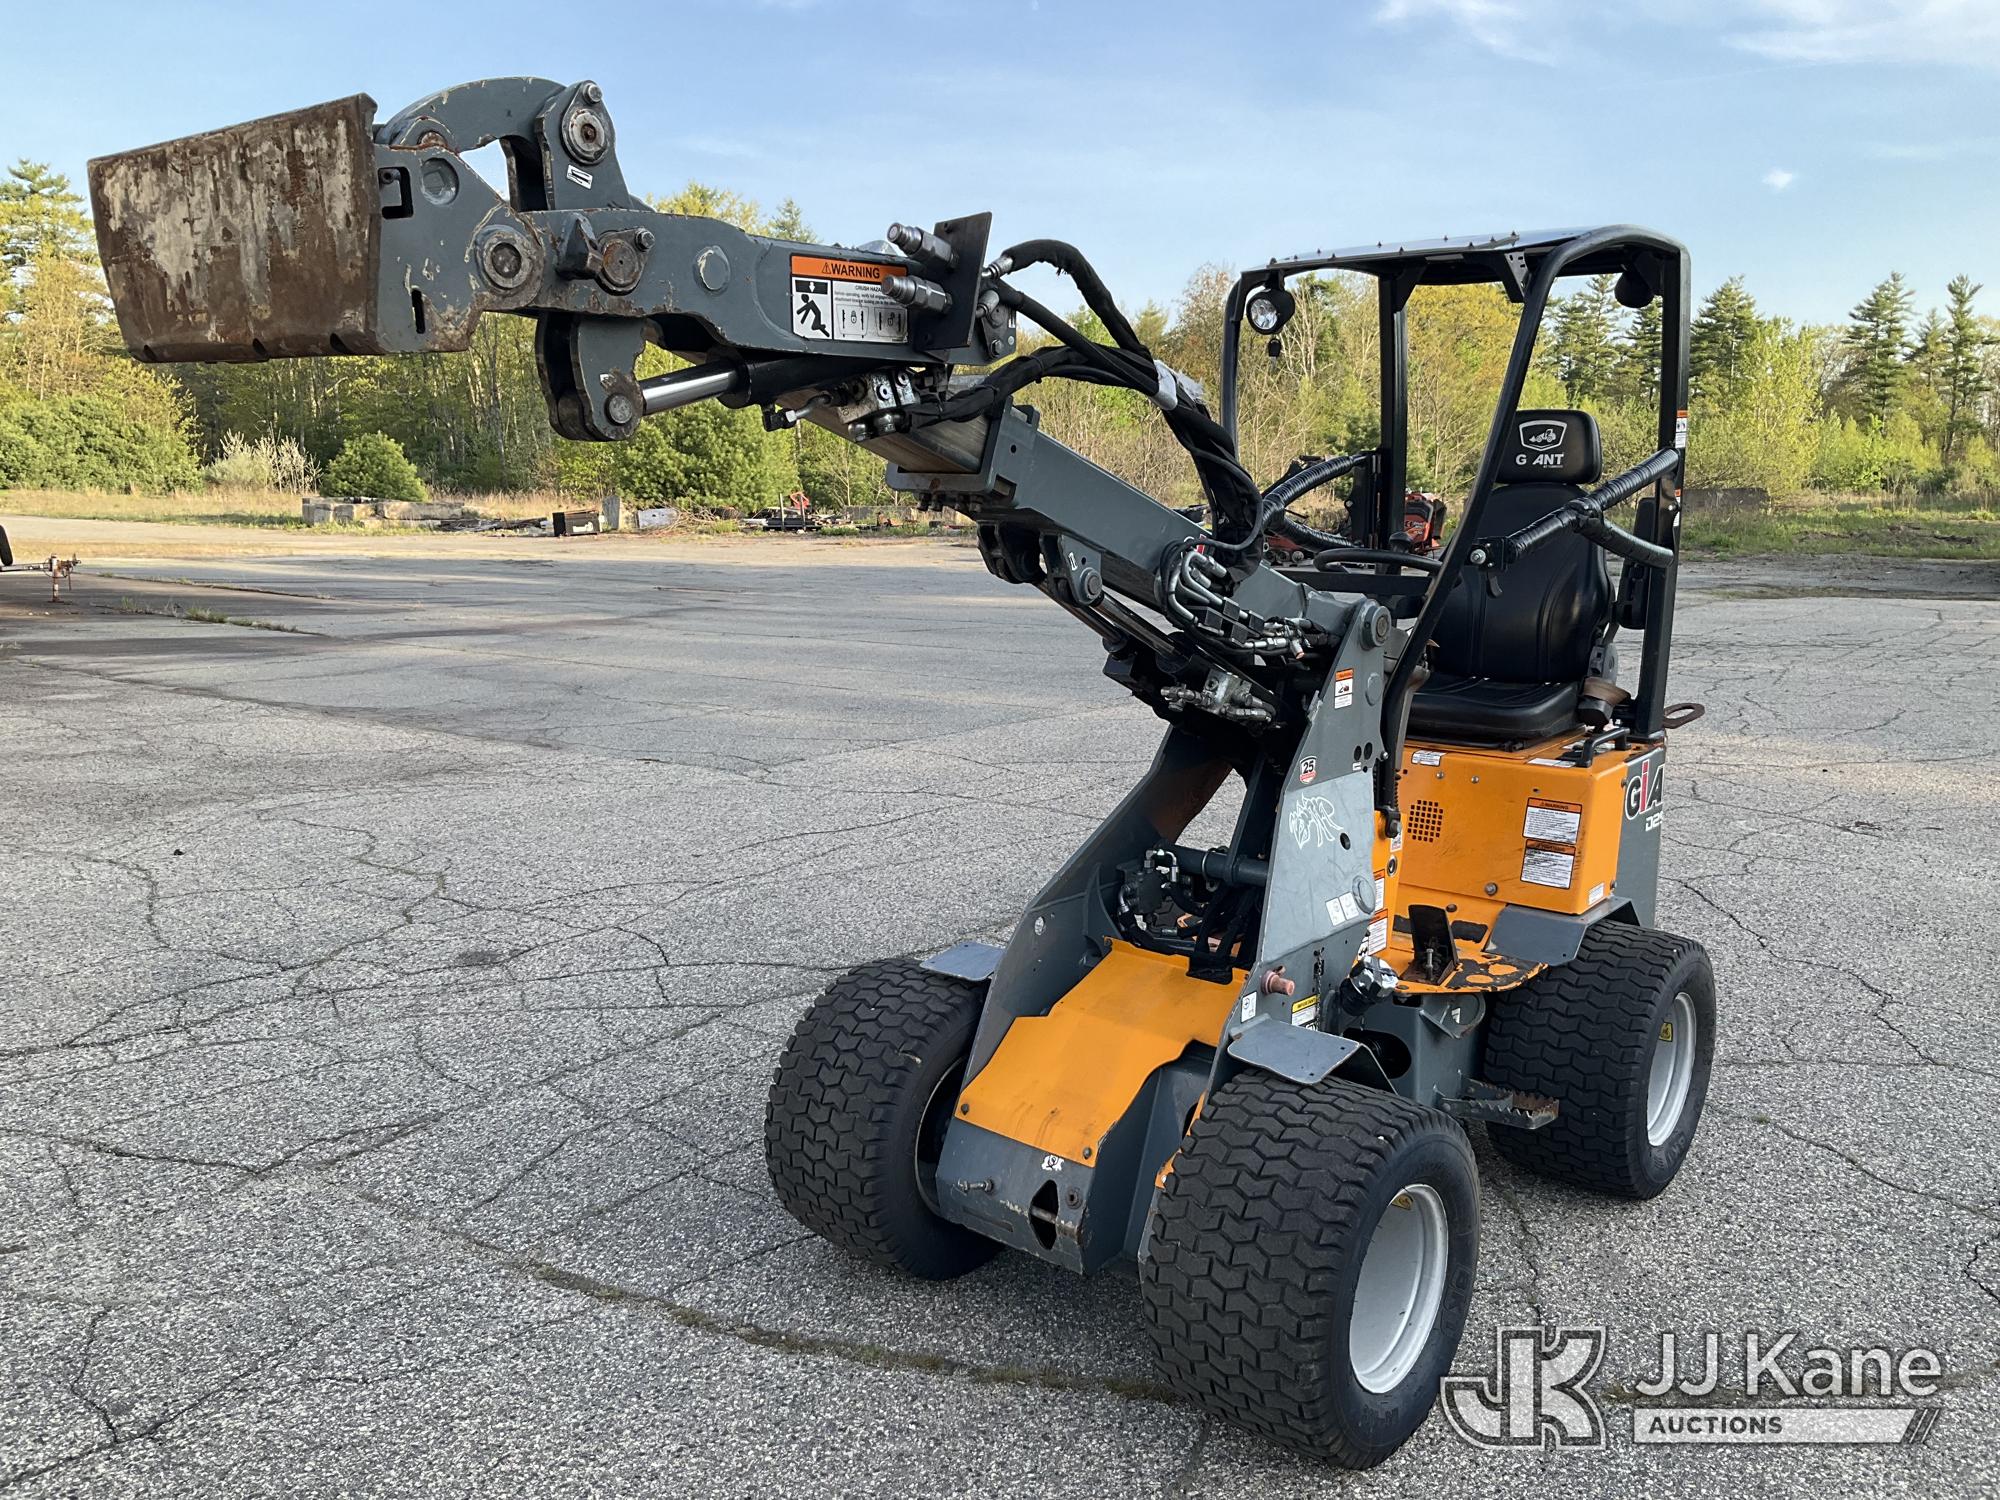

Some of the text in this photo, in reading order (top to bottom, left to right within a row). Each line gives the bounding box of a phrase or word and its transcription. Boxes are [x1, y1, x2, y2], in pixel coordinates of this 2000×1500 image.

[831, 263, 880, 279] WARNING
[1515, 453, 1564, 465] GANT
[1303, 760, 1314, 774] 25
